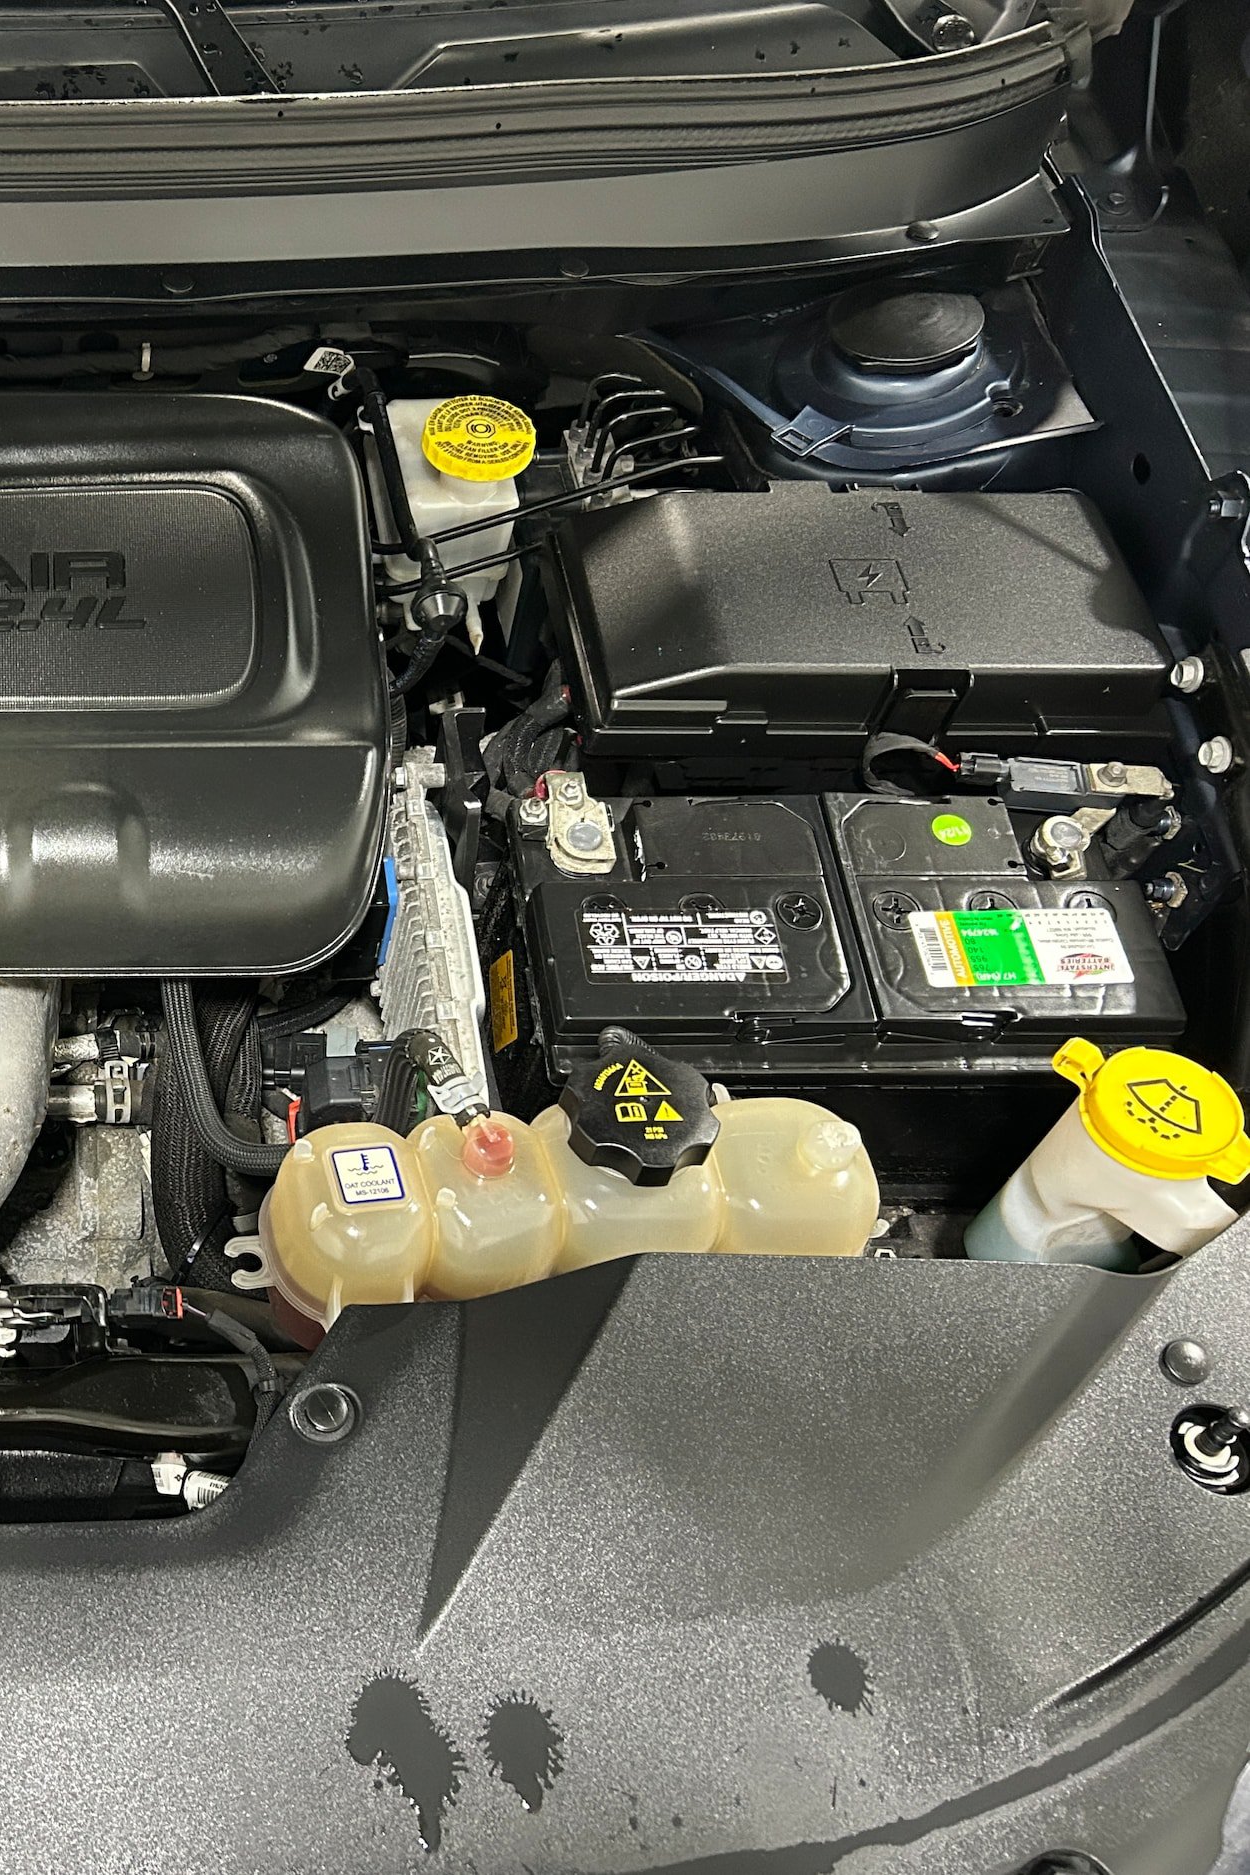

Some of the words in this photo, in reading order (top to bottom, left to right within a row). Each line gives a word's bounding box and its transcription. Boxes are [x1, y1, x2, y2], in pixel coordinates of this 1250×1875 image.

[939, 919, 967, 978] AUTOMOTIVE
[631, 972, 736, 982] DANGER/POISON
[360, 1178, 395, 1188] COOLANT
